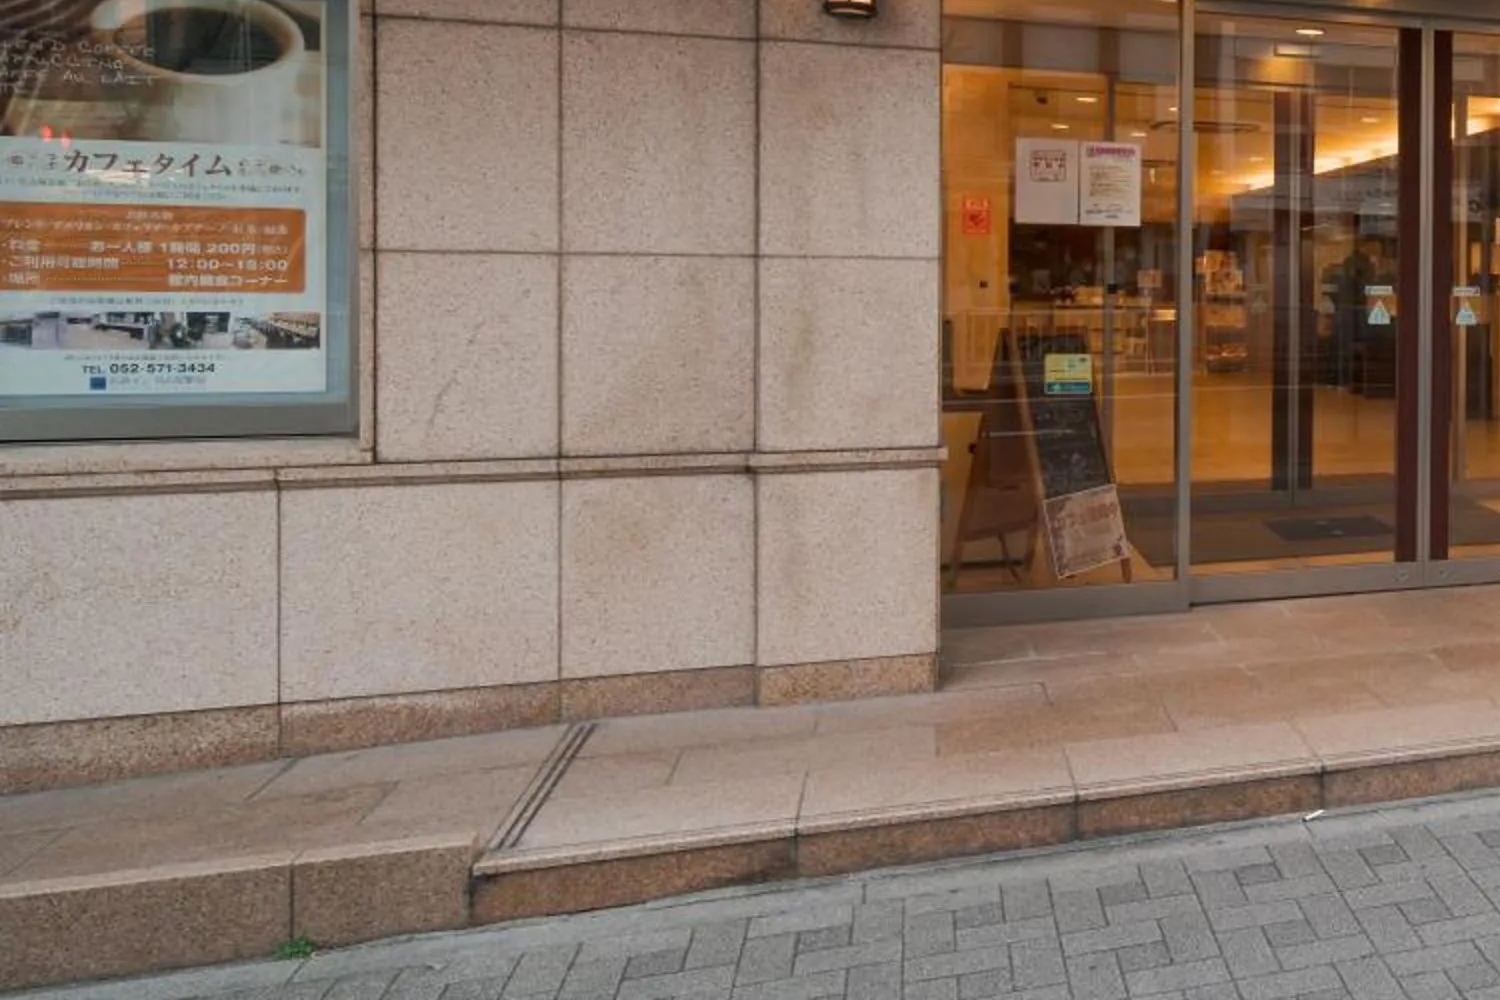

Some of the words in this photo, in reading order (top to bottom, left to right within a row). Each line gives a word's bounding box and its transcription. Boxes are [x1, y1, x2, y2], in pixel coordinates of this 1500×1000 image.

[64, 150, 232, 178] カフェタイム
